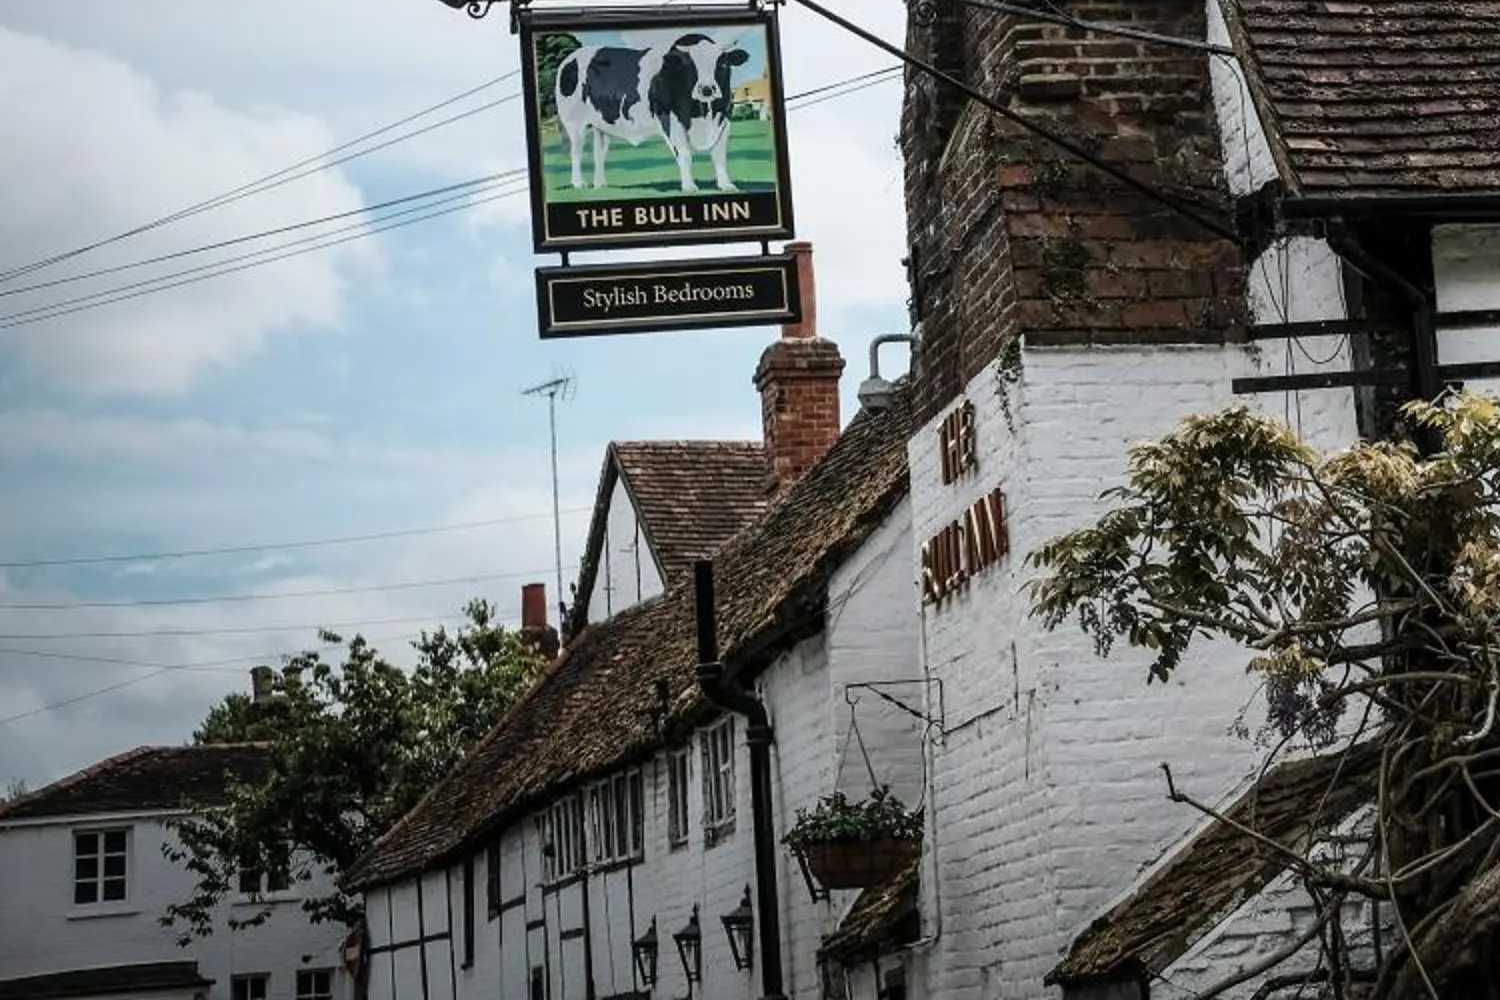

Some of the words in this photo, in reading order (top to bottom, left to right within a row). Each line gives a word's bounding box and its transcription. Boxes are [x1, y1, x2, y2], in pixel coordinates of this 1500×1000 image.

[576, 208, 623, 228] THE
[635, 205, 693, 225] BULL
[703, 201, 751, 221] INN
[583, 285, 647, 313] Stylish
[653, 282, 755, 304] Bedrooms
